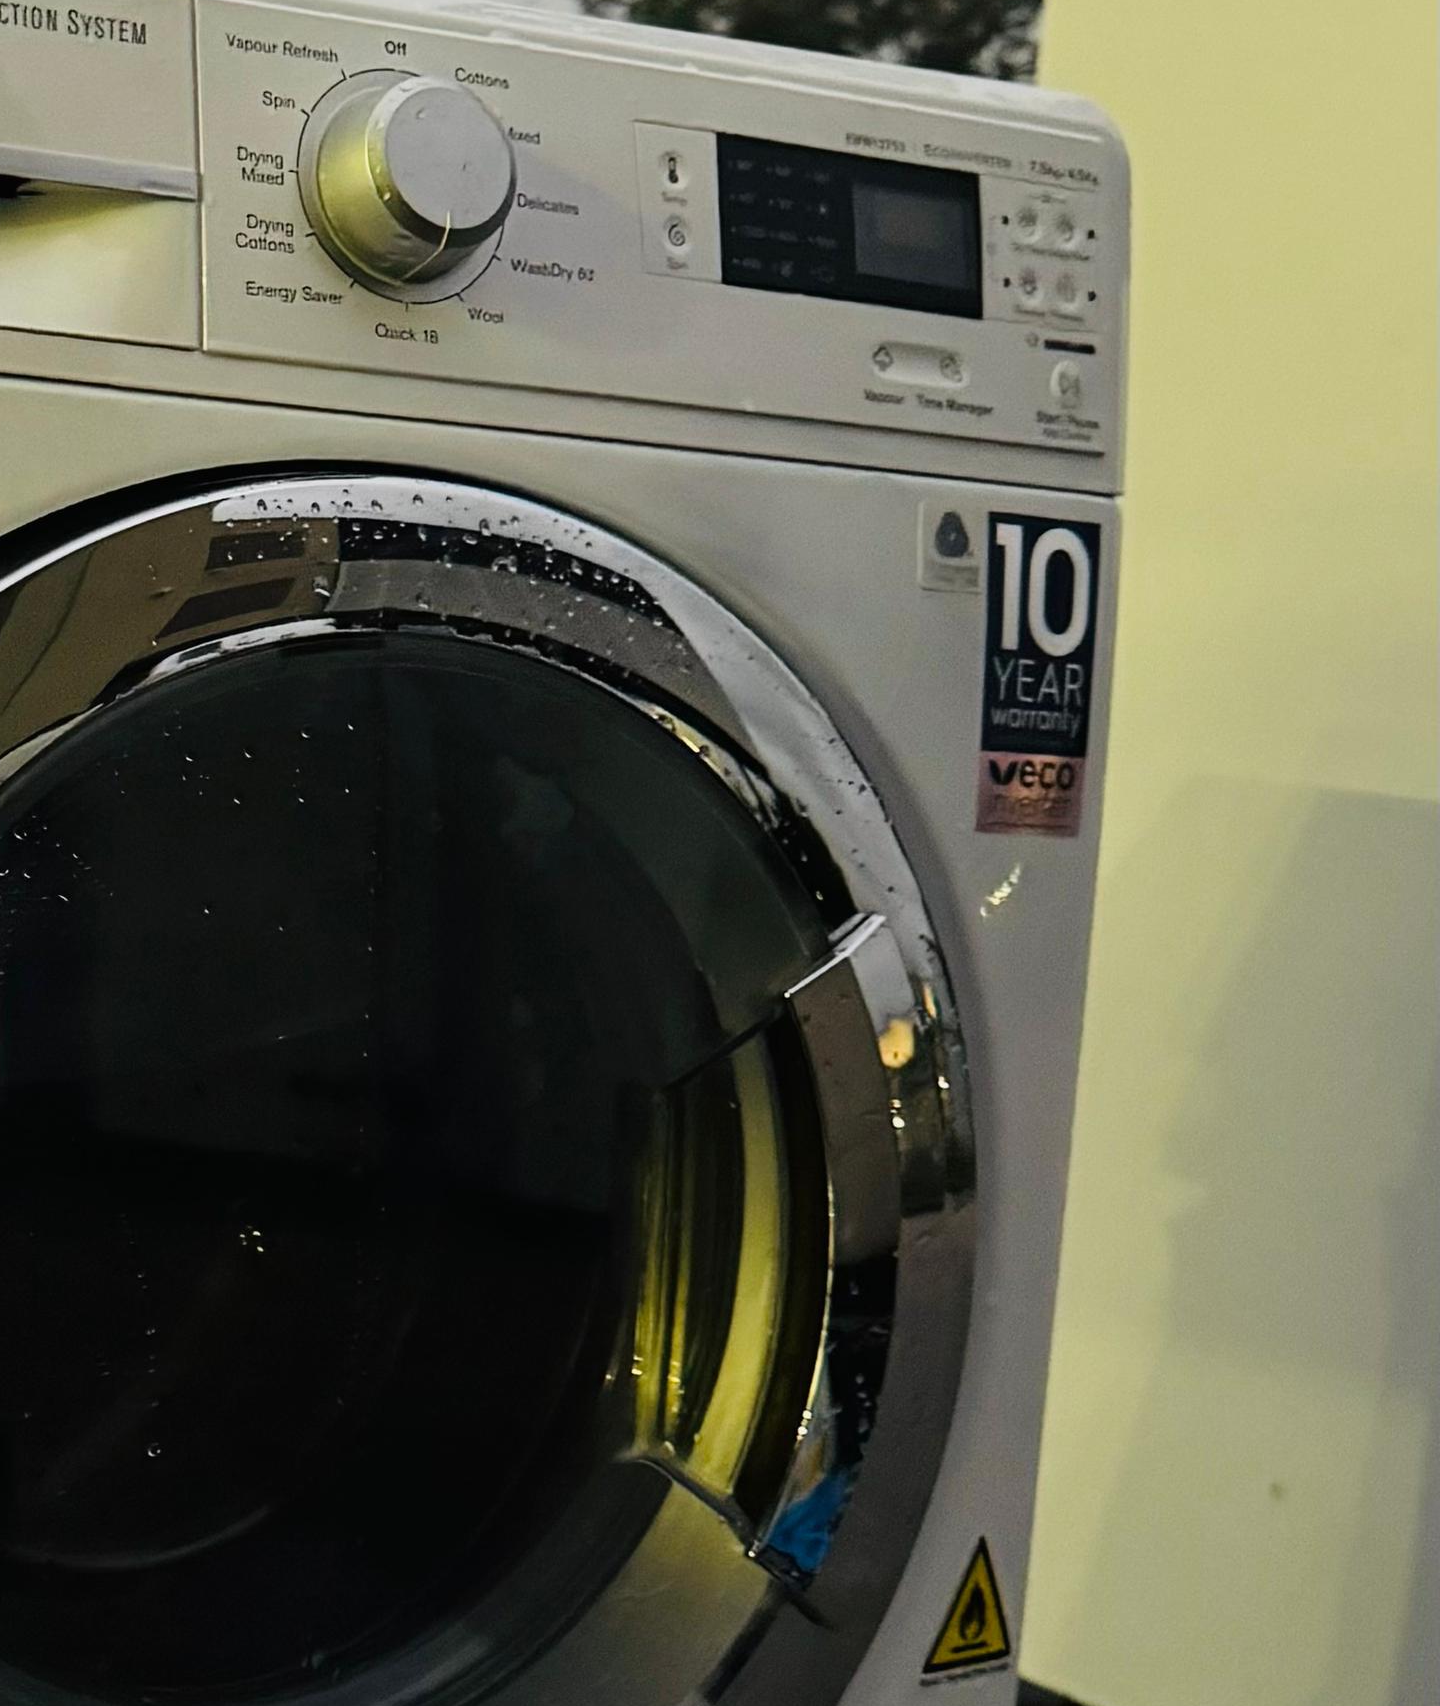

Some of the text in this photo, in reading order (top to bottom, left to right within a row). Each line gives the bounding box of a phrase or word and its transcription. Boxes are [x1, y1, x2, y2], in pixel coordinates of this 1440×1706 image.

[67, 8, 147, 45] SYSTEM
[226, 33, 338, 63] Vapour Refresh
[385, 40, 407, 56] Off
[455, 68, 509, 89] Cottons
[262, 91, 295, 110] Spin
[237, 146, 284, 169] Drying
[242, 167, 285, 186] Mixed
[517, 193, 579, 216] Delicates
[246, 214, 294, 237] Drying
[236, 233, 295, 254] Cottons
[511, 258, 573, 281] WashDry
[245, 281, 342, 305] Energy Saver
[468, 307, 504, 324] Wool
[375, 322, 417, 342] Quick
[996, 522, 1090, 657] 10
[993, 658, 1085, 706] YEAR
[991, 707, 1080, 739] warranty
